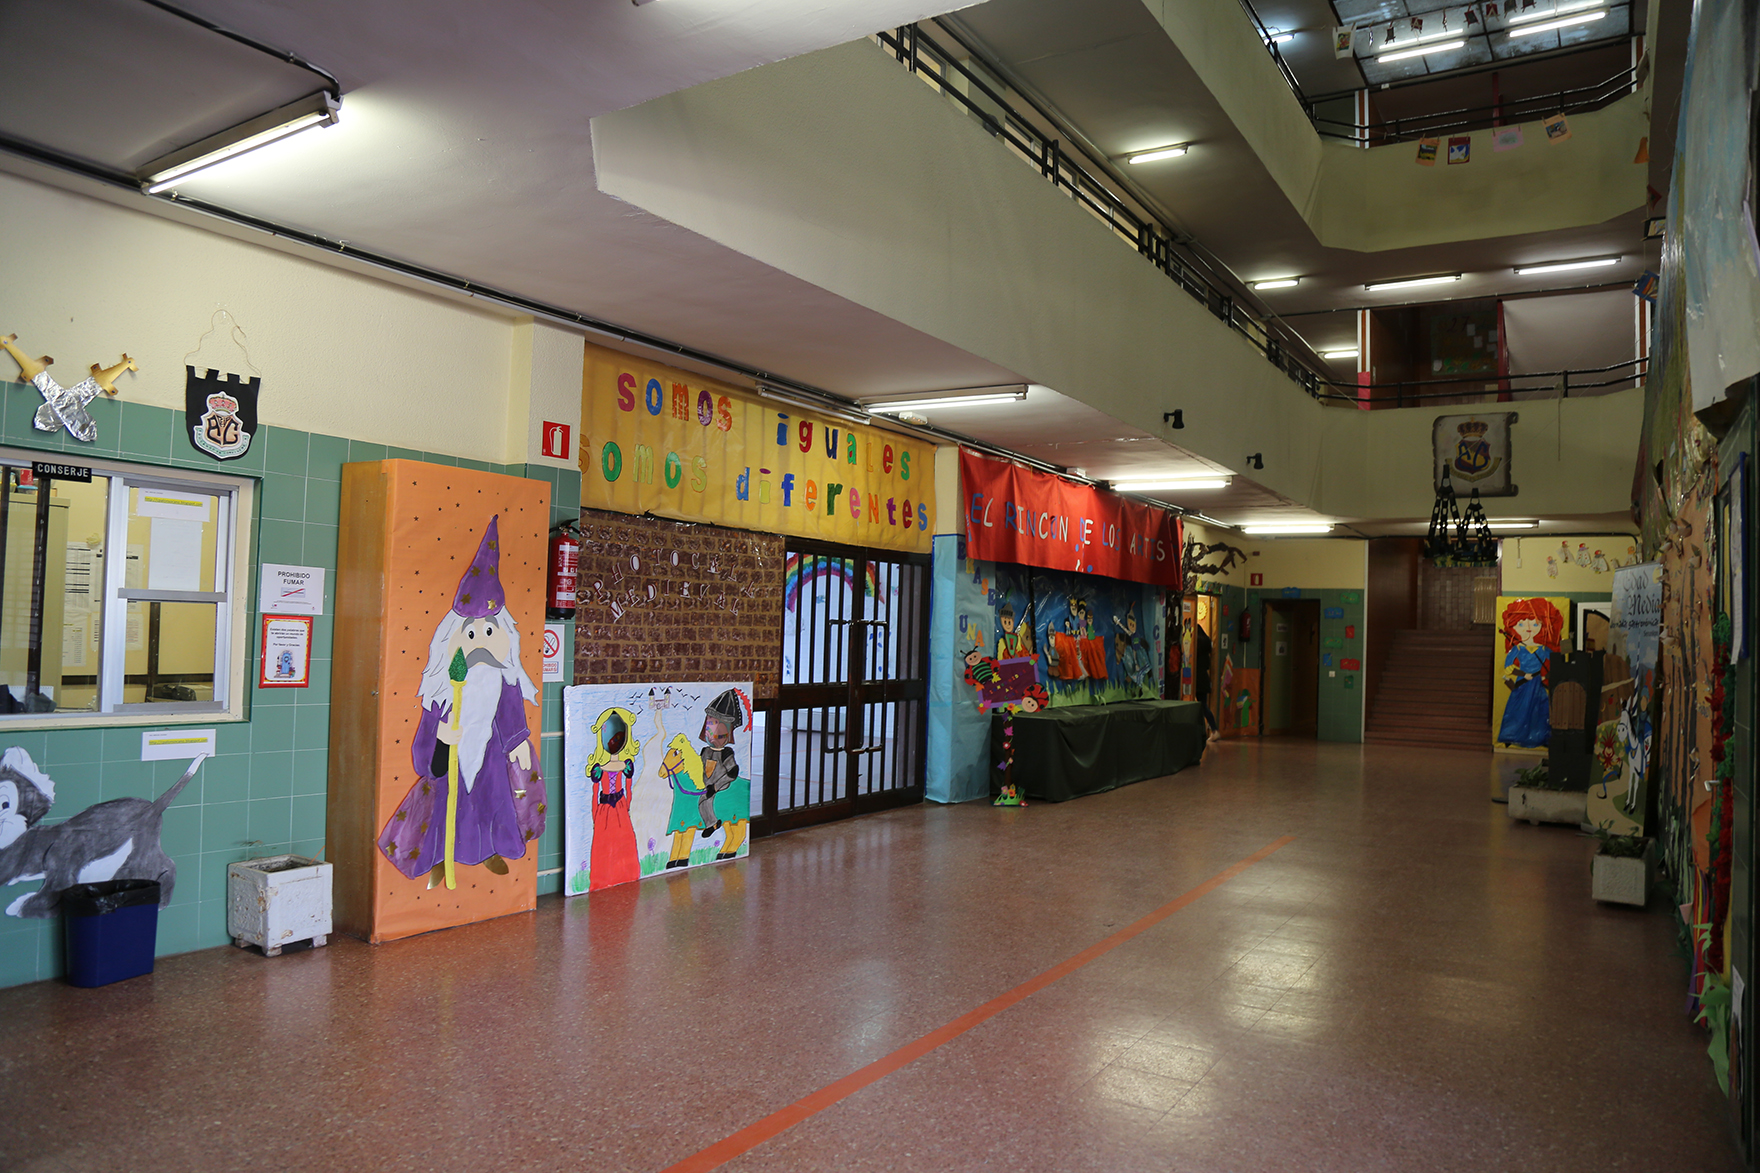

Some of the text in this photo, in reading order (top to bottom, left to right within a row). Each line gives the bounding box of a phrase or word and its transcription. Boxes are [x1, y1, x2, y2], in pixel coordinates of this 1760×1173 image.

[776, 412, 911, 480] iguales
[37, 463, 89, 478] CONSERJE
[970, 492, 994, 527] EL
[1079, 516, 1094, 545] DE
[1102, 521, 1121, 551] LOS
[277, 571, 311, 579] PROHIBIDO
[593, 548, 755, 600] PHOTOCALL
[609, 579, 739, 623] MEDIEVAL
[1626, 593, 1660, 616] Media
[959, 614, 985, 648] UNA
